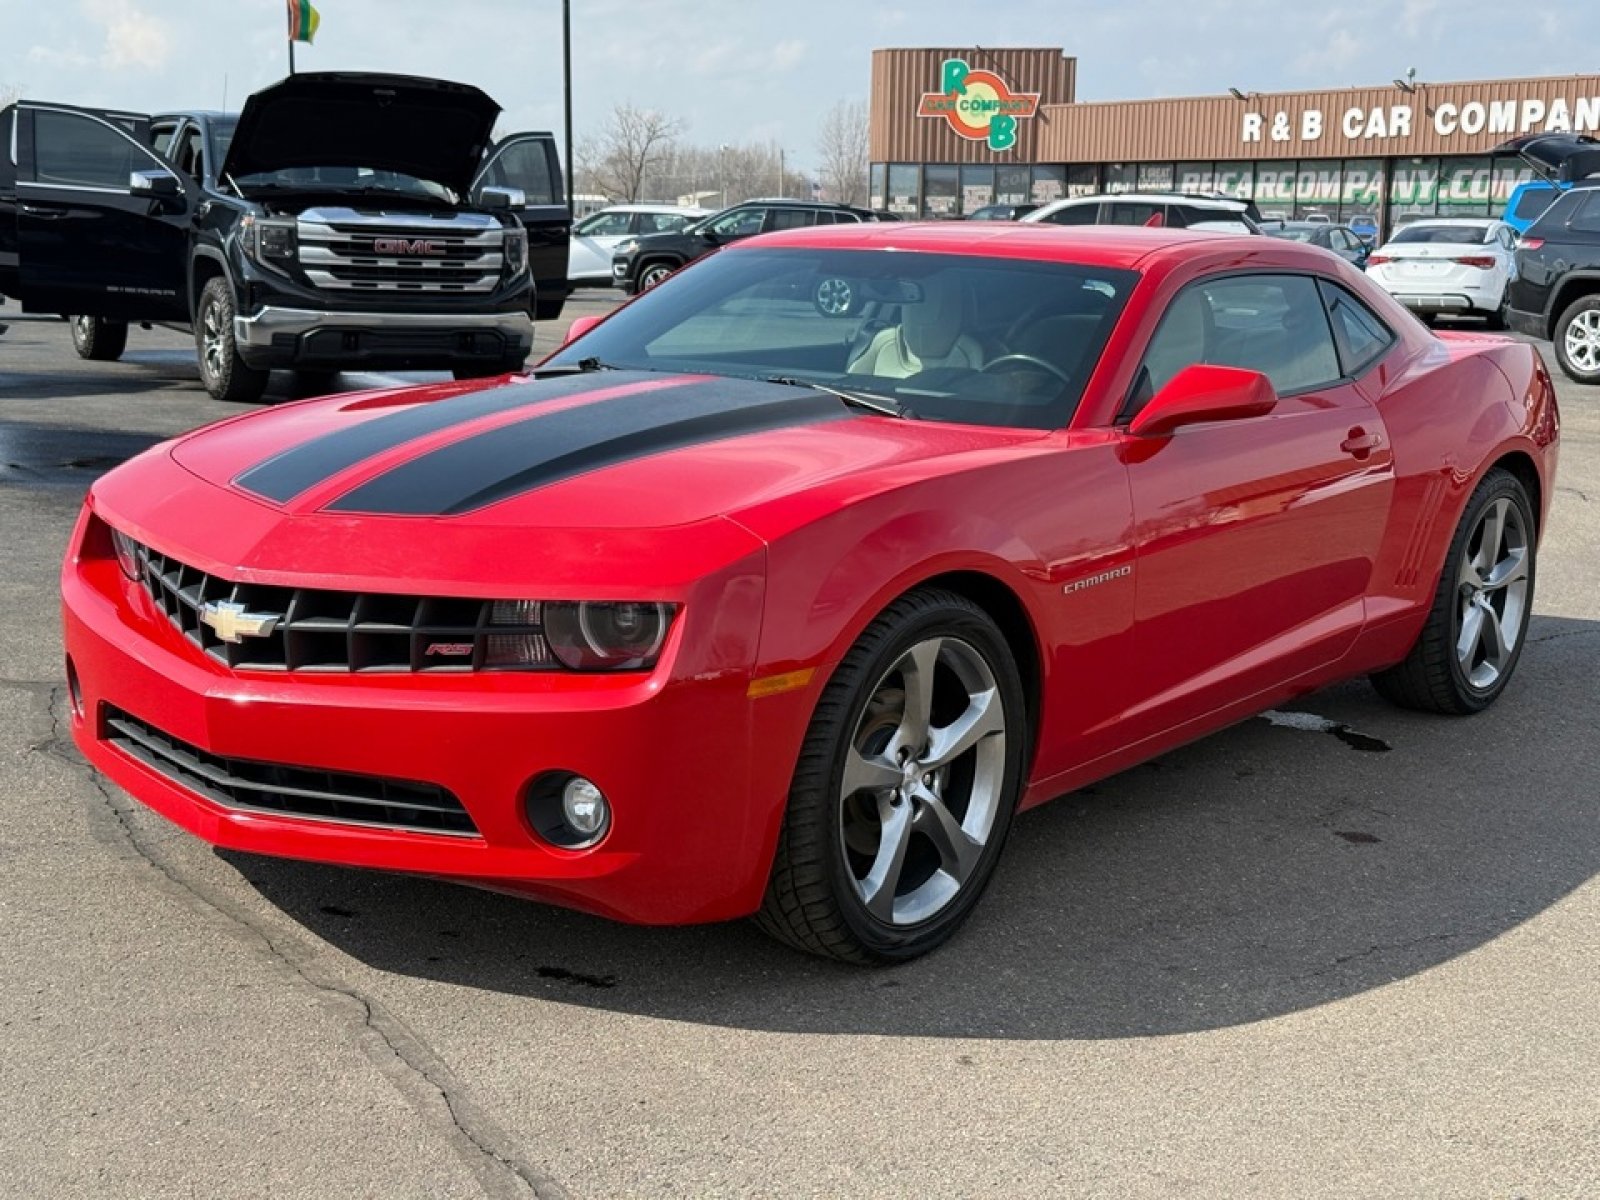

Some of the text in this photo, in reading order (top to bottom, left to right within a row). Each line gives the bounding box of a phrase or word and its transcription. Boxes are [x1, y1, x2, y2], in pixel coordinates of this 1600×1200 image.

[941, 58, 970, 96] R
[988, 114, 1017, 151] B
[1242, 112, 1262, 142] R
[1271, 111, 1291, 141] &
[1302, 109, 1323, 141] B
[1342, 105, 1412, 139] CAR
[374, 239, 447, 255] GMC
[1064, 565, 1131, 594] CAMARO
[425, 643, 474, 656] RS
